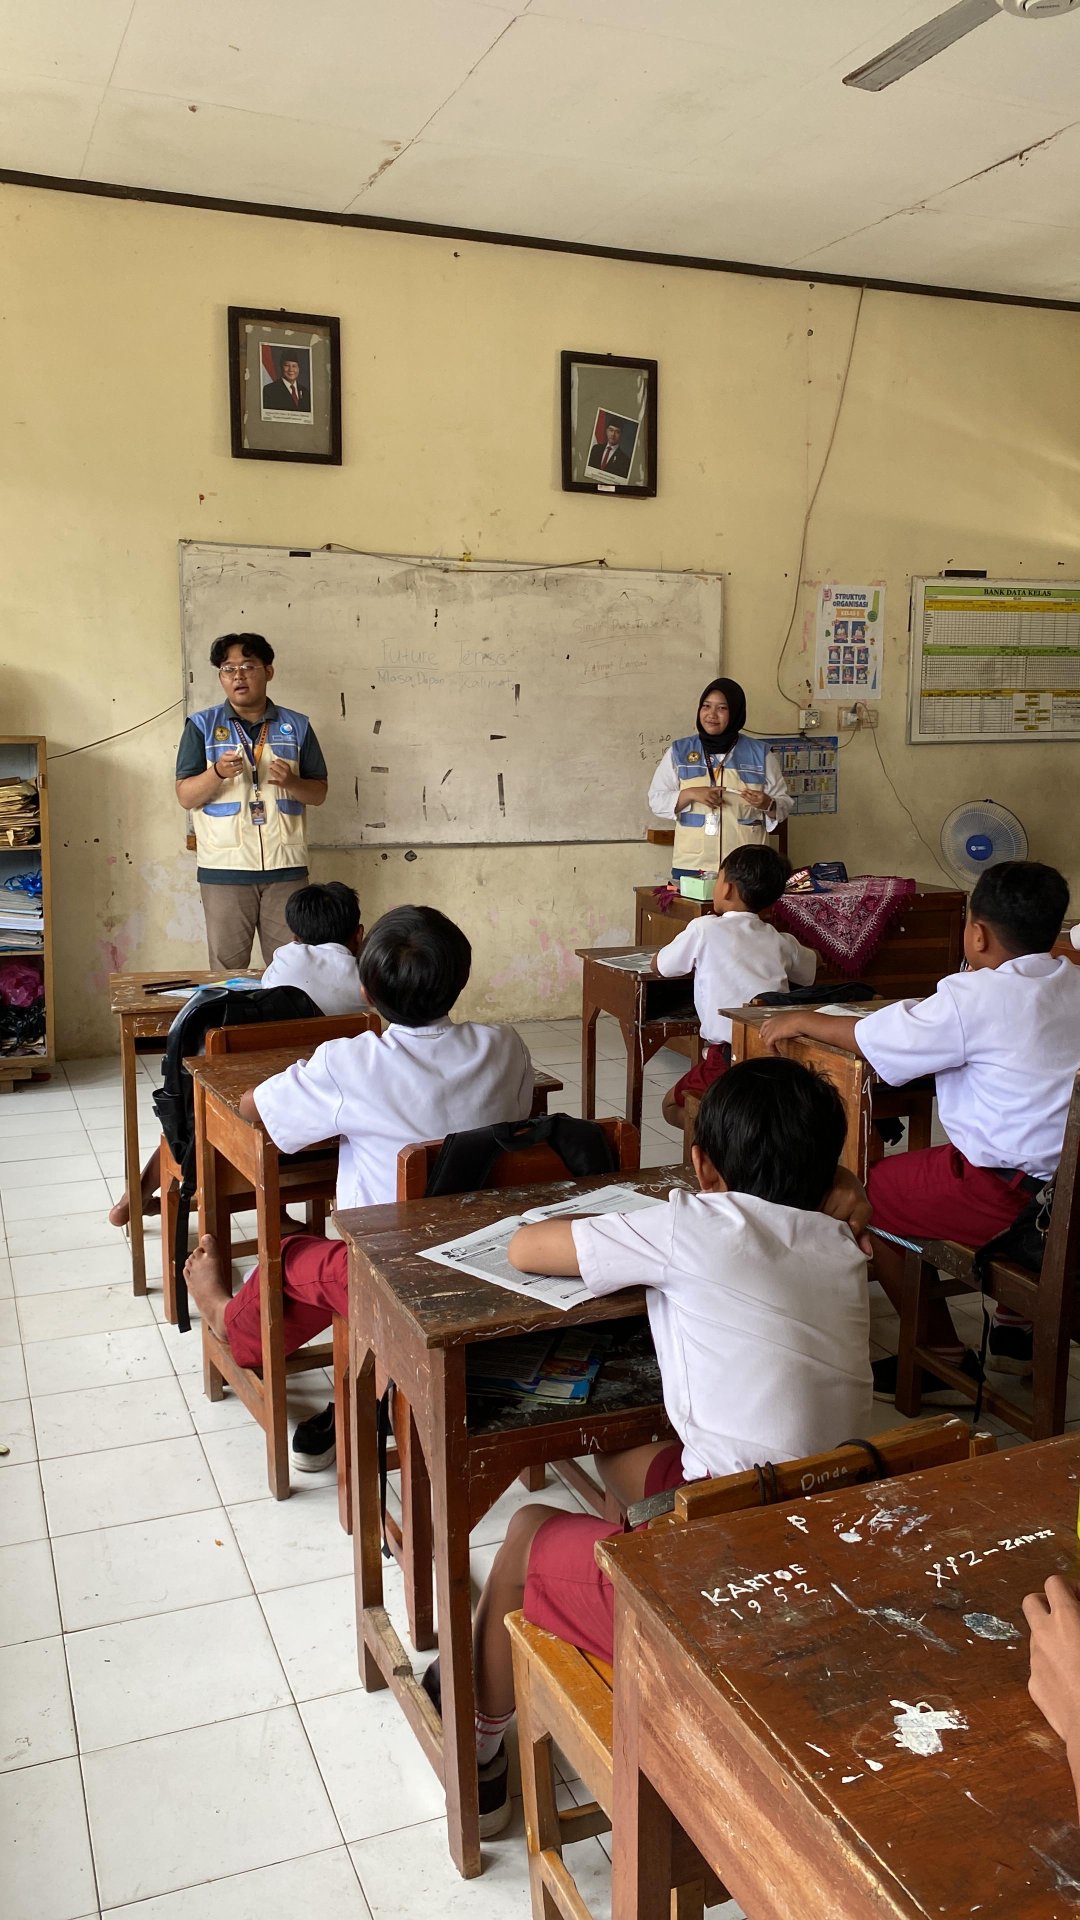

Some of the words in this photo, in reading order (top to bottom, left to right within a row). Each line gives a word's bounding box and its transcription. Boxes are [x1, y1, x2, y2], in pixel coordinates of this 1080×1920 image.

[835, 593, 867, 601] STRUKTUR
[983, 588, 1005, 597] BANK
[1006, 589, 1027, 597] DATA
[1028, 590, 1052, 598] KELAS
[832, 600, 869, 608] ORGANISASI
[380, 637, 439, 665] Future
[800, 1465, 848, 1491] Dinda
